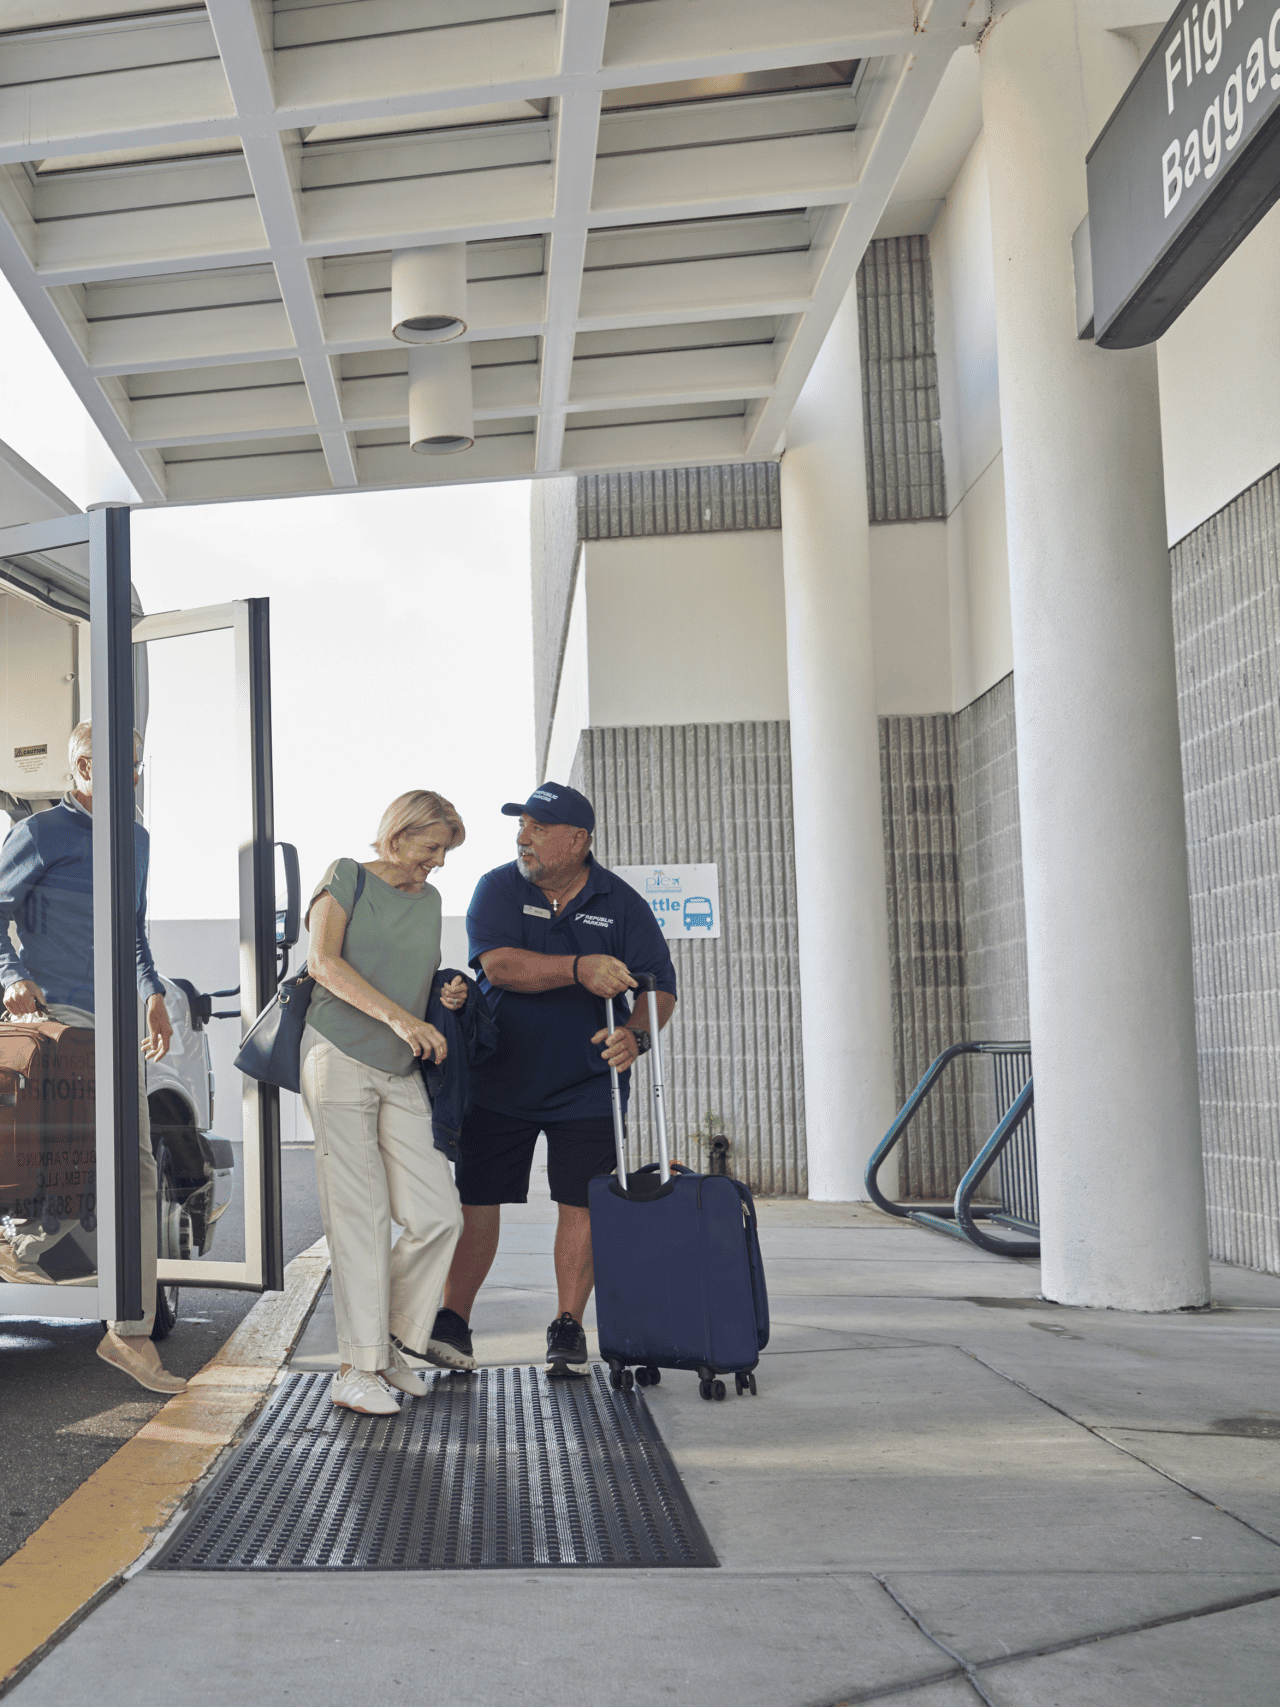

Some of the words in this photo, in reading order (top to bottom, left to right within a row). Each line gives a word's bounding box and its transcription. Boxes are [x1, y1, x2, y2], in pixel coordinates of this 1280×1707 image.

[23, 747, 46, 755] CAUTION
[648, 898, 681, 911] ttle
[582, 919, 609, 928] PARKING
[584, 914, 614, 925] REPUBLIC
